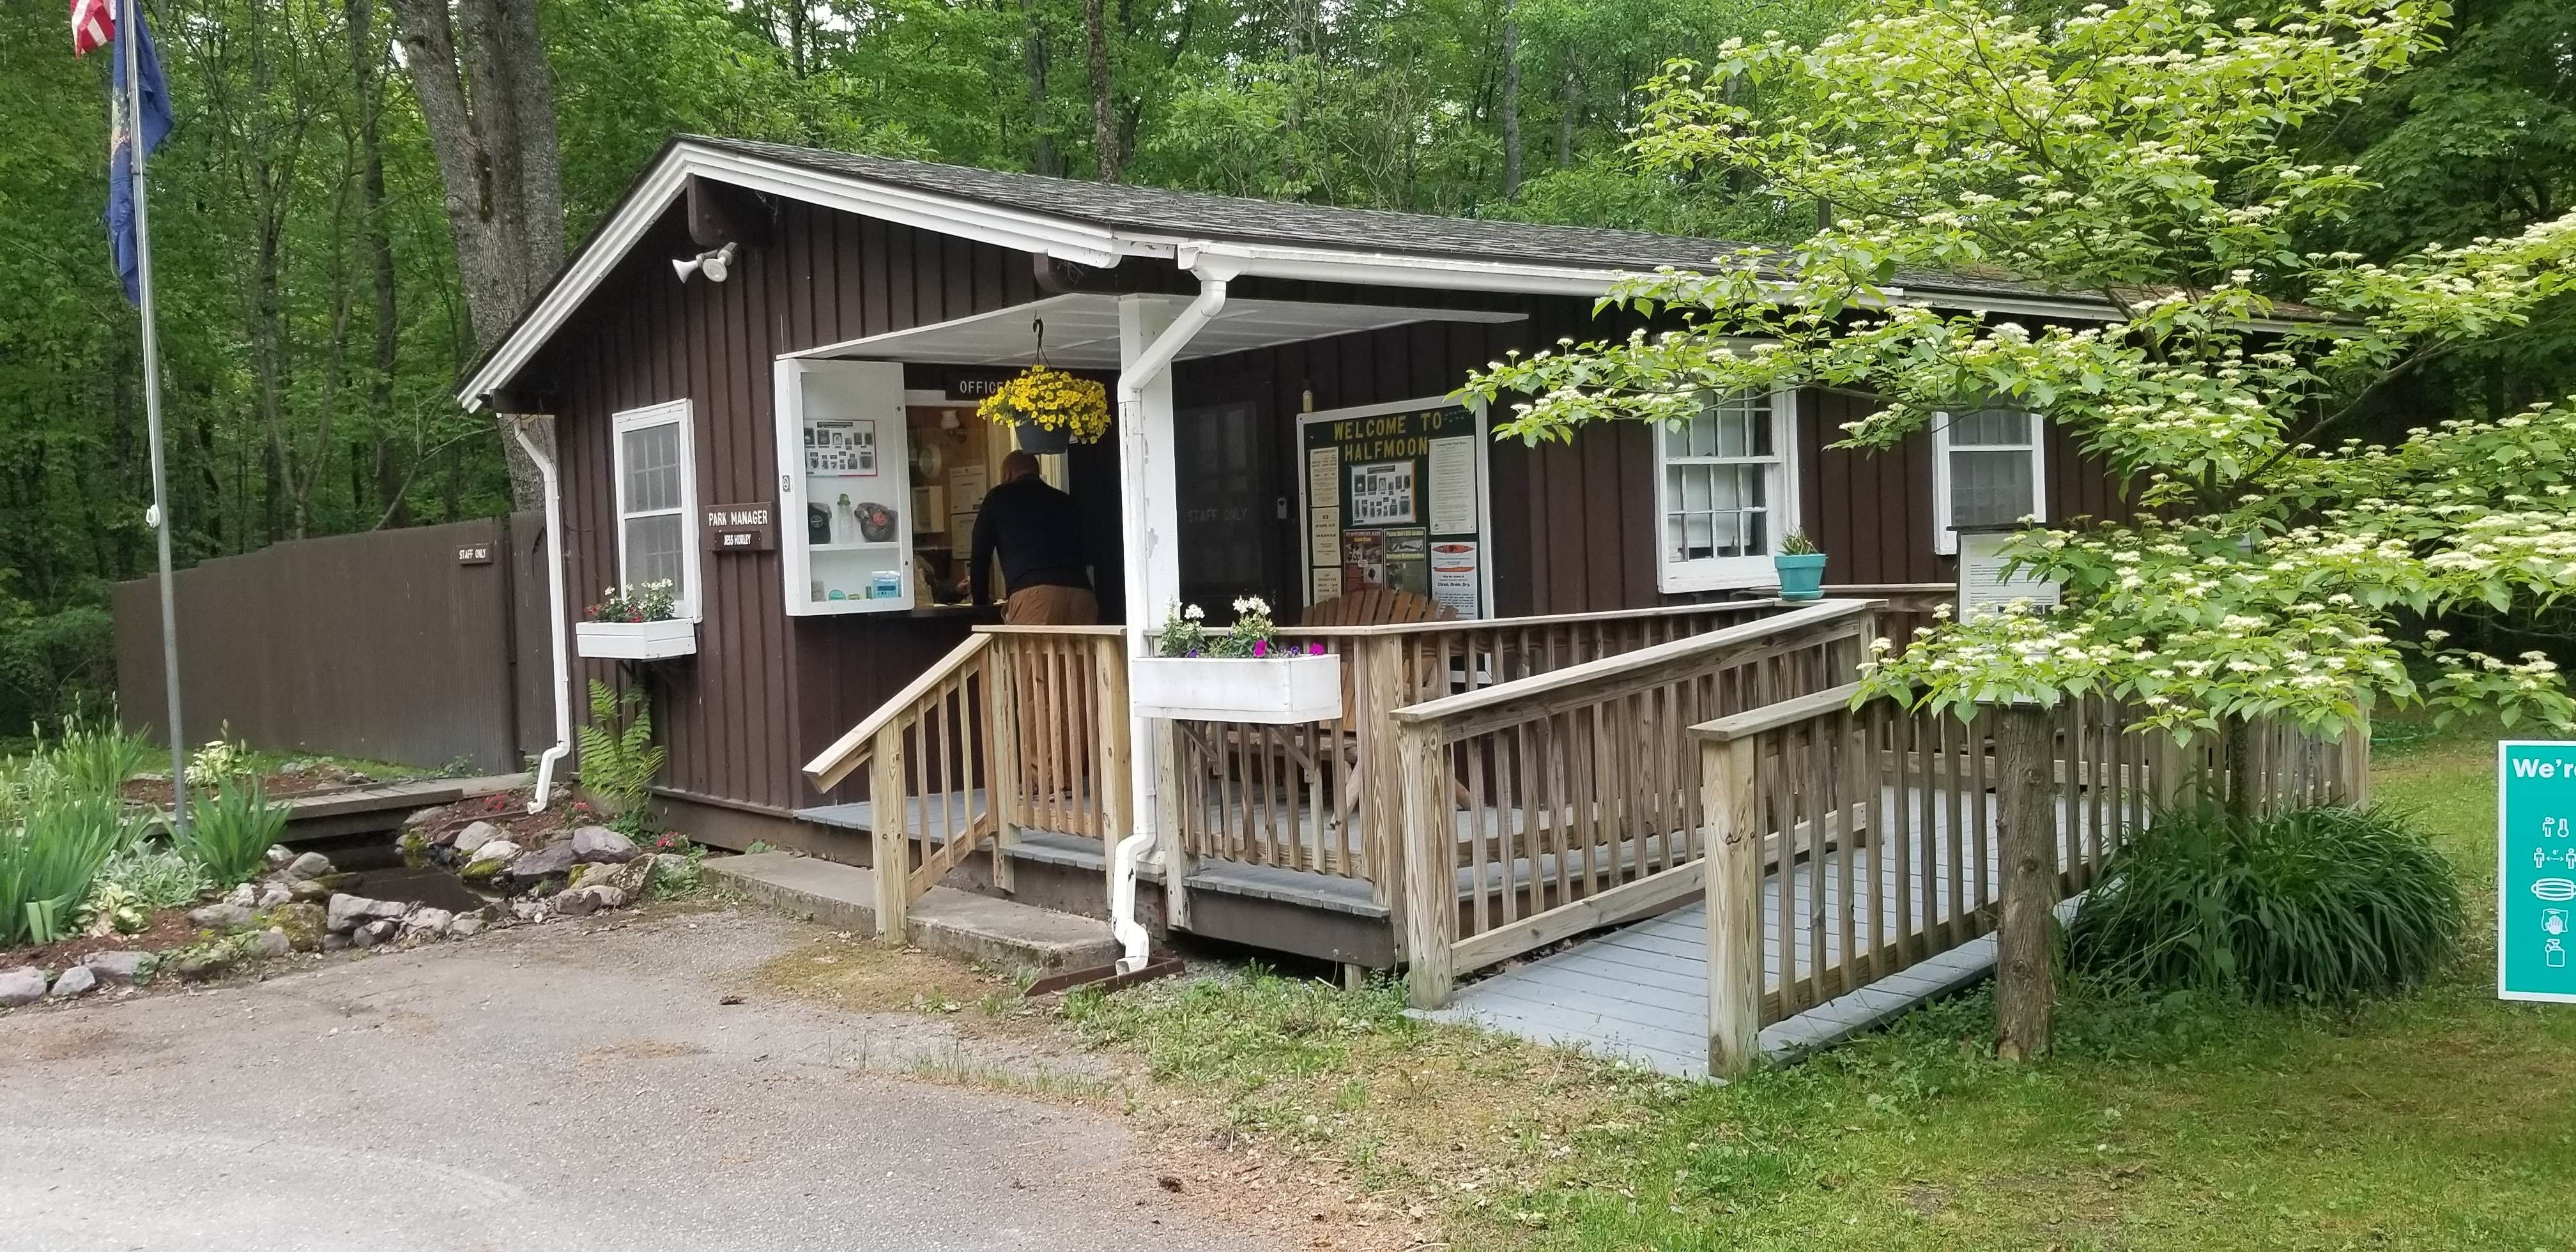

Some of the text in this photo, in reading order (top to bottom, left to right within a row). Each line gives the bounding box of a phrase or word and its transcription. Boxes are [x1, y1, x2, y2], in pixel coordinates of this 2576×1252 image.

[1334, 415, 1406, 441] WELCOME
[1420, 411, 1441, 431] TO
[1345, 436, 1427, 462] HALFMOON
[709, 510, 768, 526] PARK MANAGER
[1186, 509, 1217, 523] STAFF
[723, 533, 751, 546] JESS HURLEY
[459, 548, 486, 560] STAFF ONLY
[2512, 758, 2576, 779] We'r
